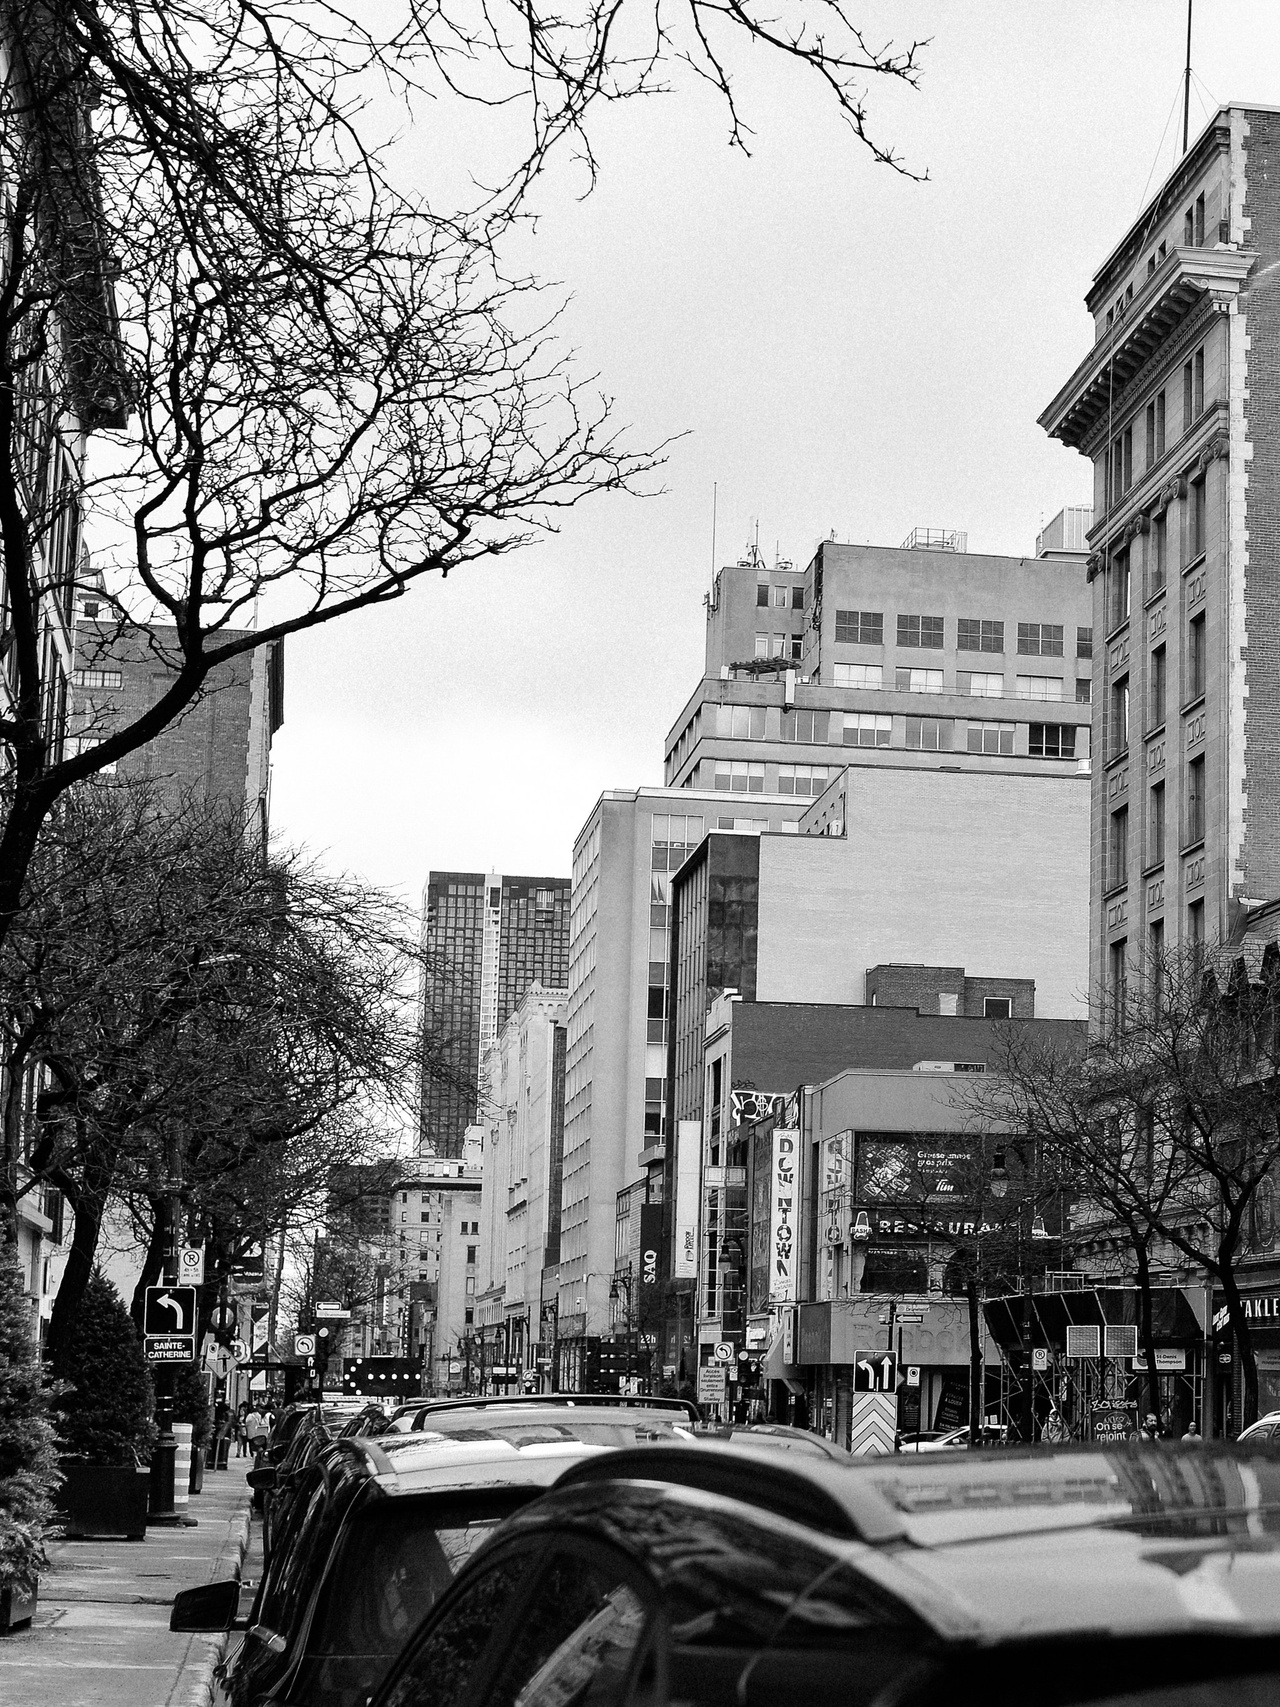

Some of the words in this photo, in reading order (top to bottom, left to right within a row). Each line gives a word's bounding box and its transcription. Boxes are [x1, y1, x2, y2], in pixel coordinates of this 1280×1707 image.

[879, 1220, 1018, 1236] RESAURAN
[643, 1250, 658, 1284] SAQ
[153, 1342, 186, 1350] SAINTE-
[148, 1350, 191, 1359] CATHERINE
[1096, 1422, 1110, 1431] On
[1096, 1430, 1127, 1443] rejoint
